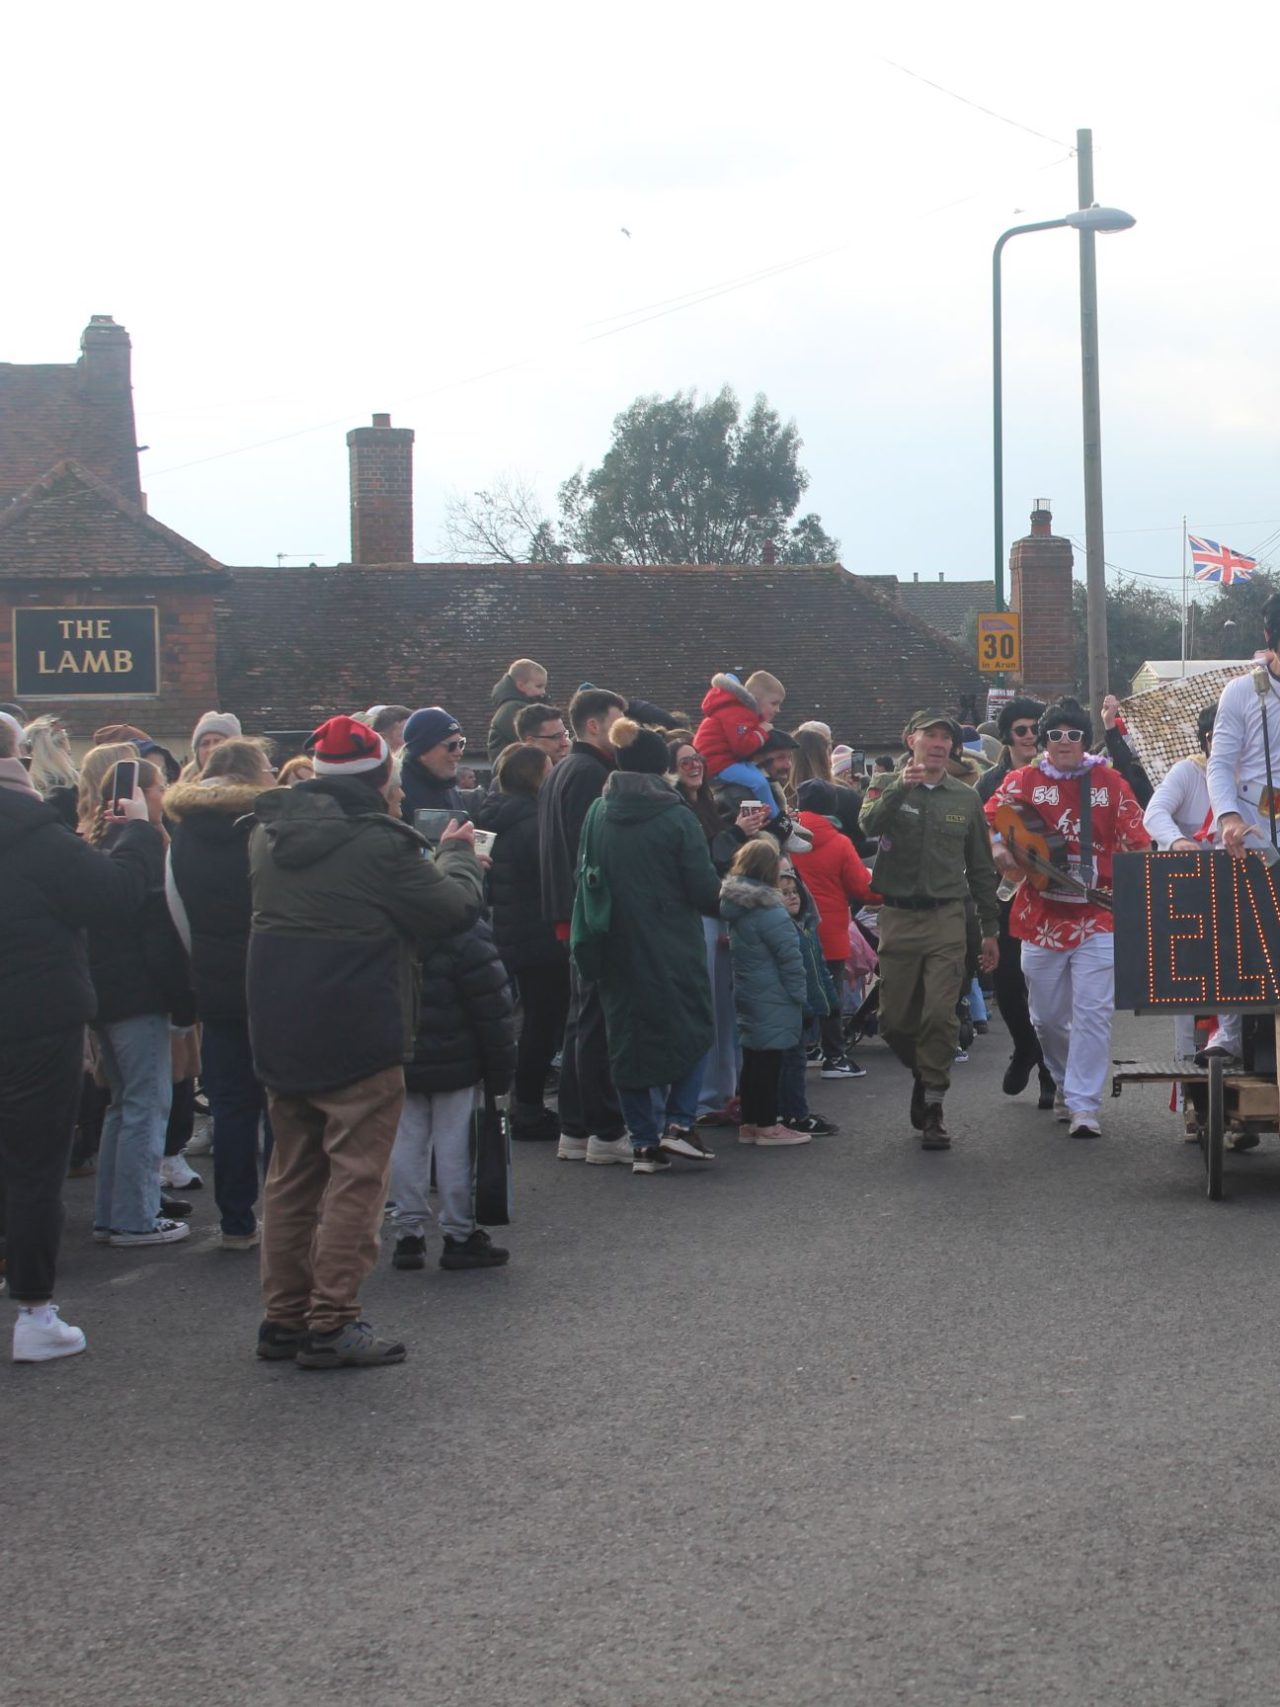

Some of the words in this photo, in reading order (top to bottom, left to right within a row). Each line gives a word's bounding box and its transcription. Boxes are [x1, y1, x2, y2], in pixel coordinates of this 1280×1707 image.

[58, 620, 113, 639] THE
[983, 633, 1014, 660] 30
[37, 649, 134, 675] LAMB
[982, 661, 991, 669] in
[994, 661, 1016, 669] Arun
[1031, 784, 1060, 806] 54
